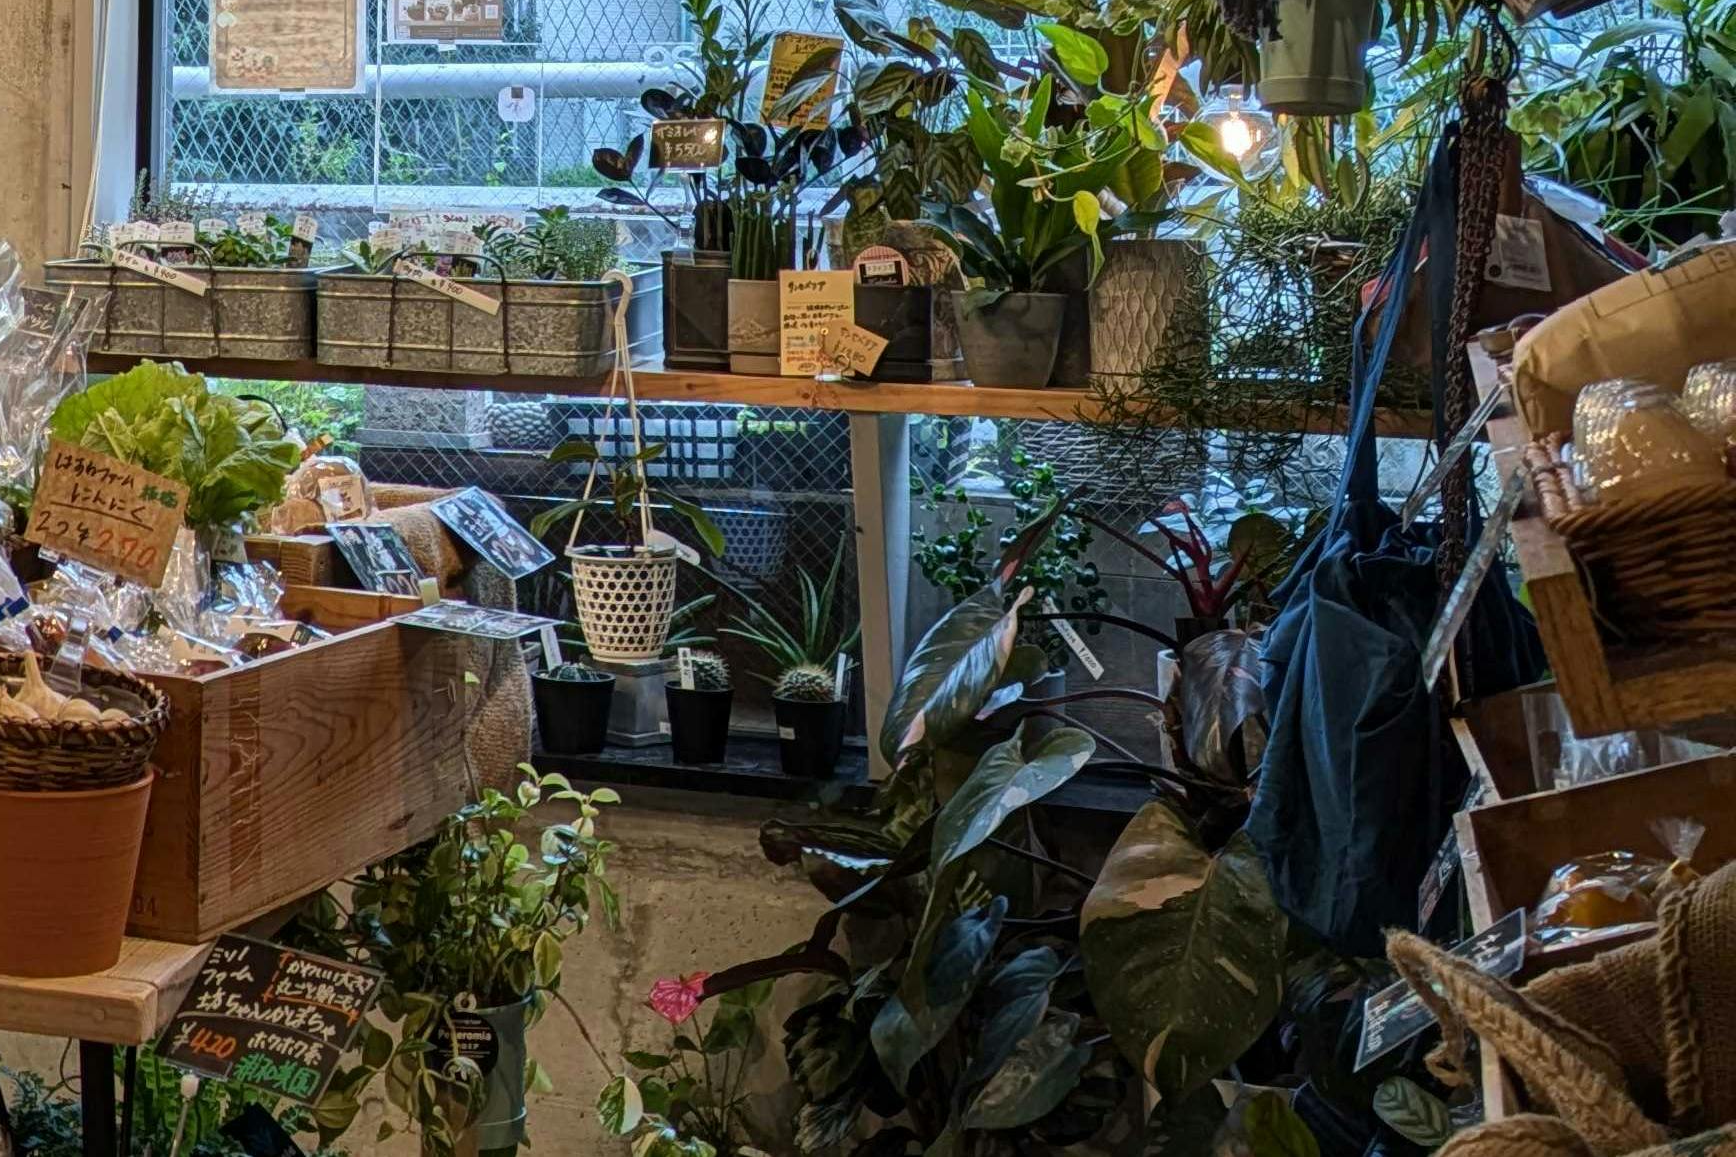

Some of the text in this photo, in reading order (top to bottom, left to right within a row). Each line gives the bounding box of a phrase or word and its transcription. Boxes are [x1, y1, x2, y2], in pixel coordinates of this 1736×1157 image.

[70, 483, 147, 523] にんにく
[76, 521, 158, 569] ¥270
[201, 964, 255, 987] ファーム
[195, 987, 338, 1043] 坊ちゃんかぼちゃ
[172, 1021, 237, 1060] ¥420
[438, 1029, 492, 1042] Peeromia
